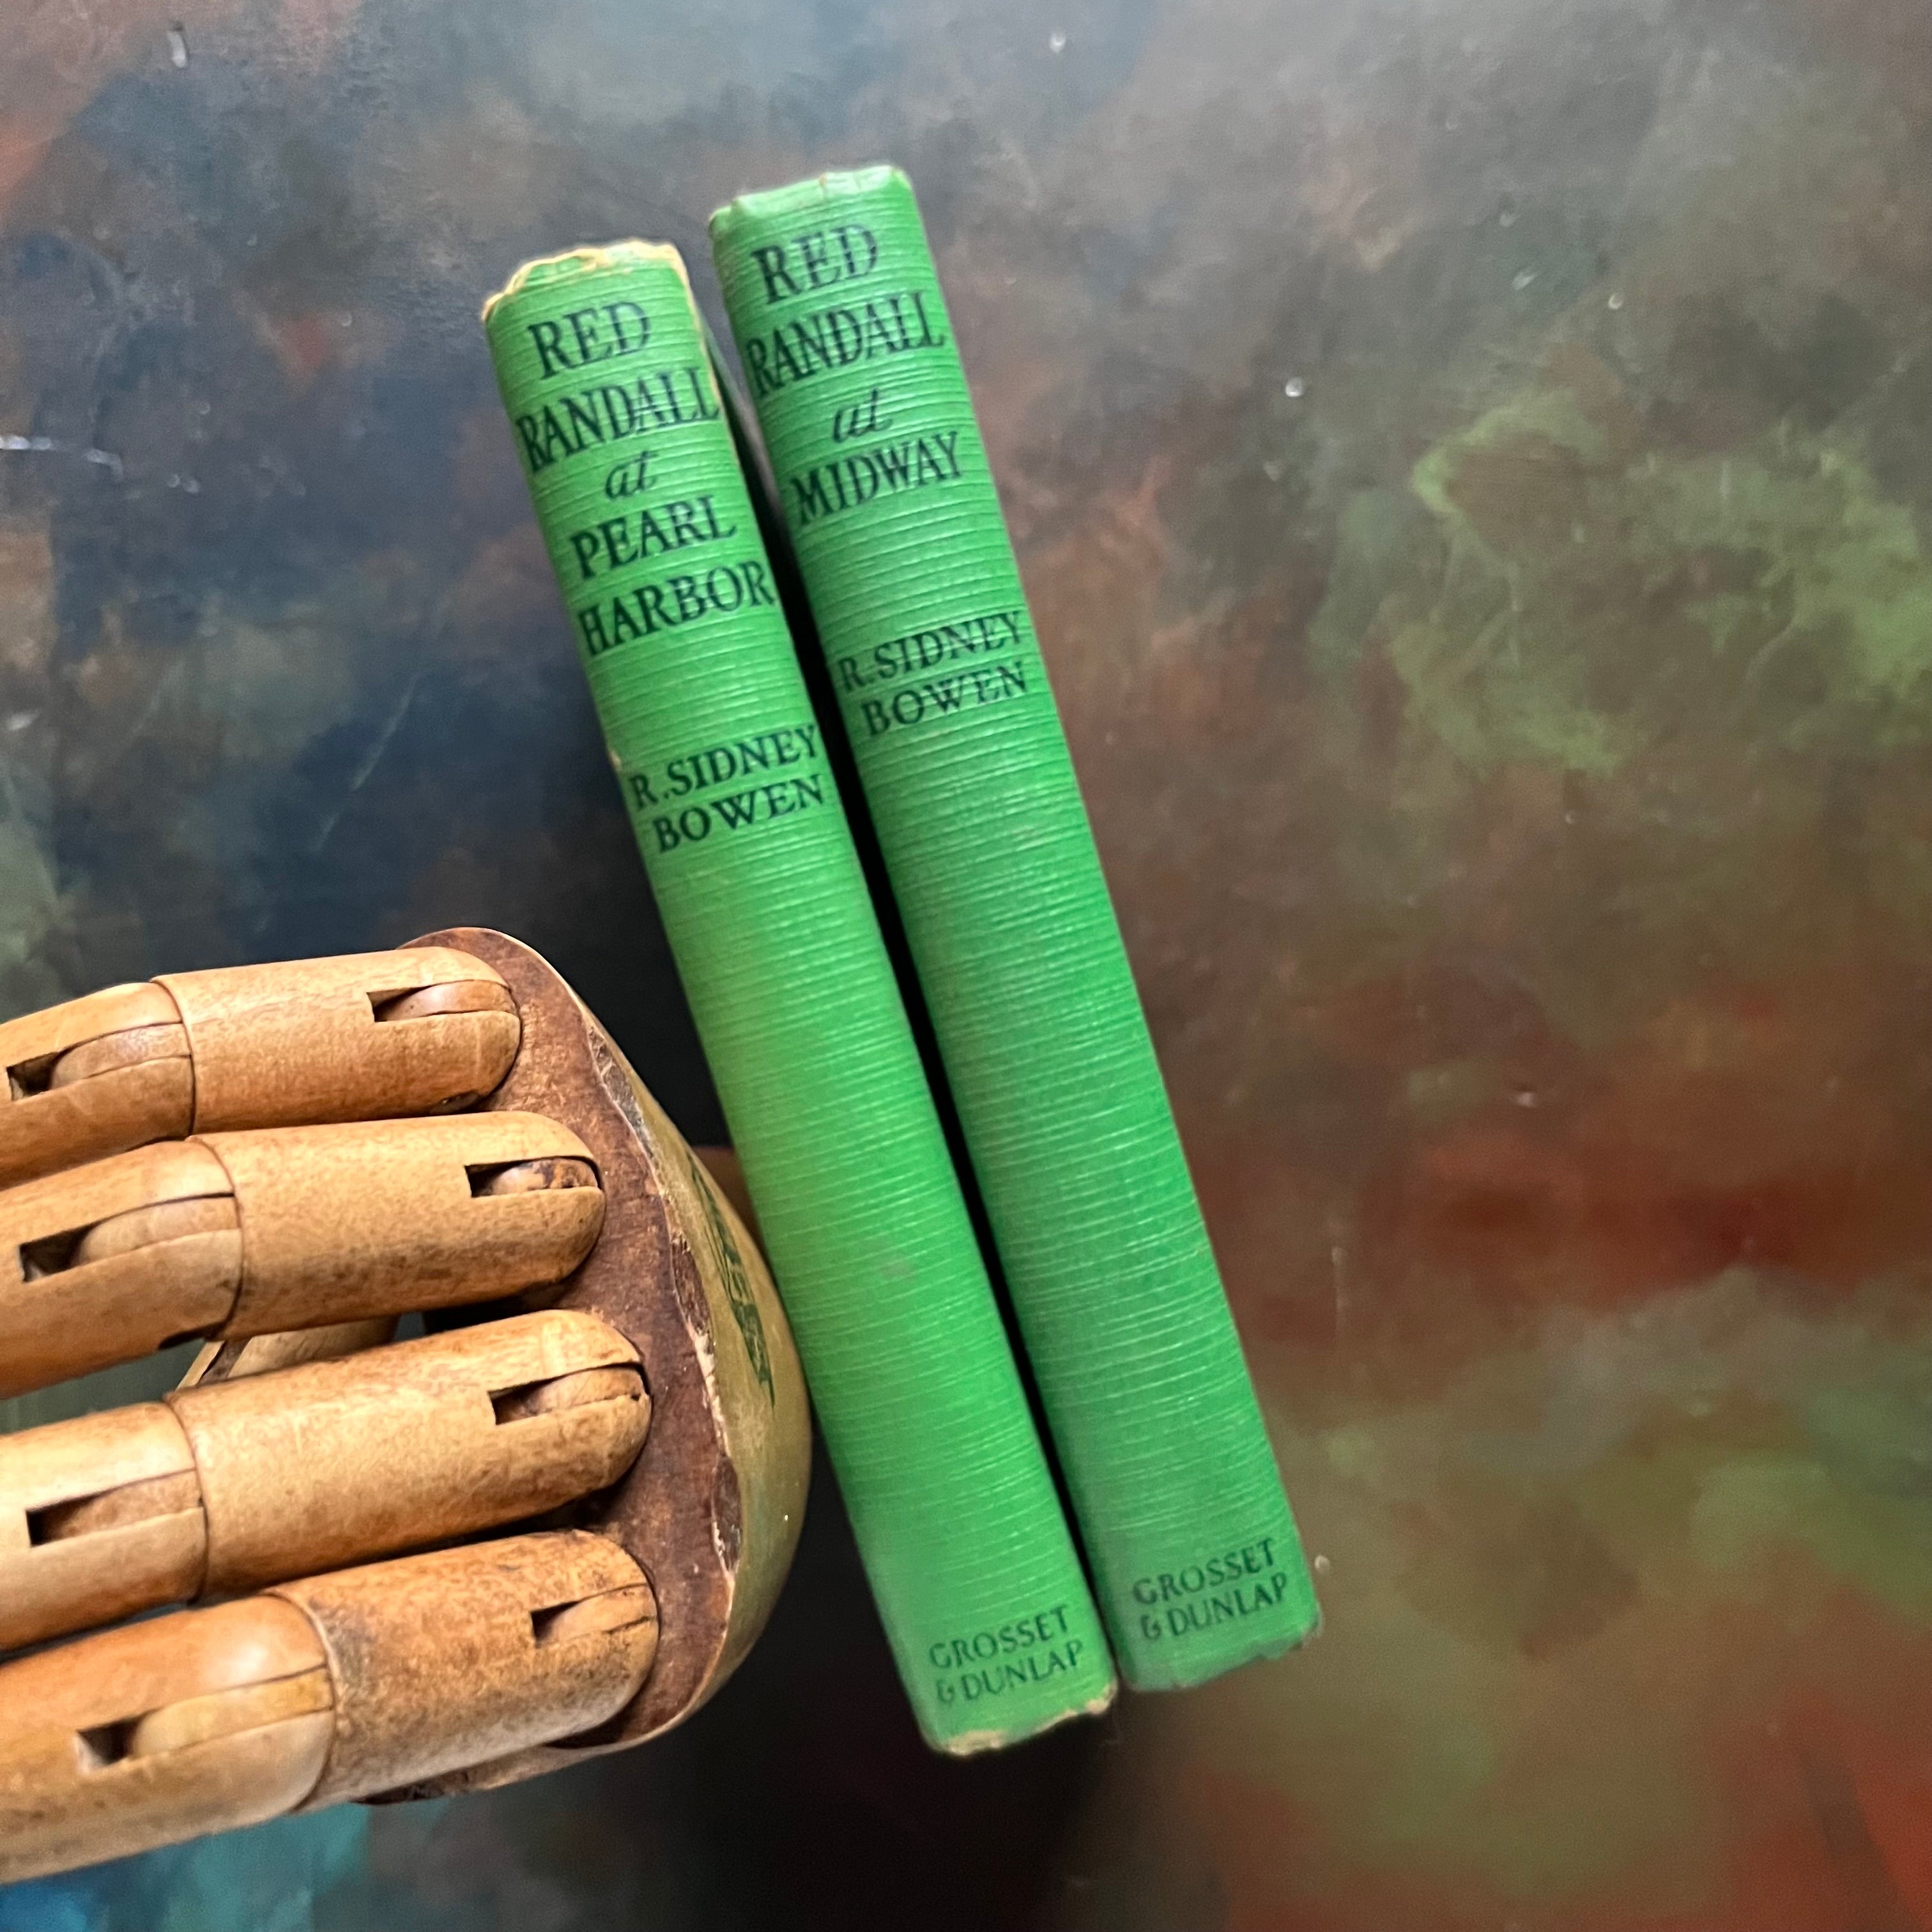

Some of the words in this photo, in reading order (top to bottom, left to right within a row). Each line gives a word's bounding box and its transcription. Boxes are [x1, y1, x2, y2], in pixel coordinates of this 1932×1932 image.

[751, 225, 878, 305] RED
[528, 302, 651, 380] RED
[746, 291, 944, 399] RANDALL
[516, 367, 721, 475] RANDALL
[833, 388, 892, 443] at
[604, 450, 659, 500] at
[791, 431, 962, 526] MIDWAY
[570, 495, 737, 580] PEARL
[578, 560, 775, 656] HARBOR
[862, 661, 1029, 737] BOWEN
[653, 774, 825, 852] BOWEN
[1133, 1538, 1275, 1605] GROSSET
[929, 1604, 1070, 1669] GROSSET
